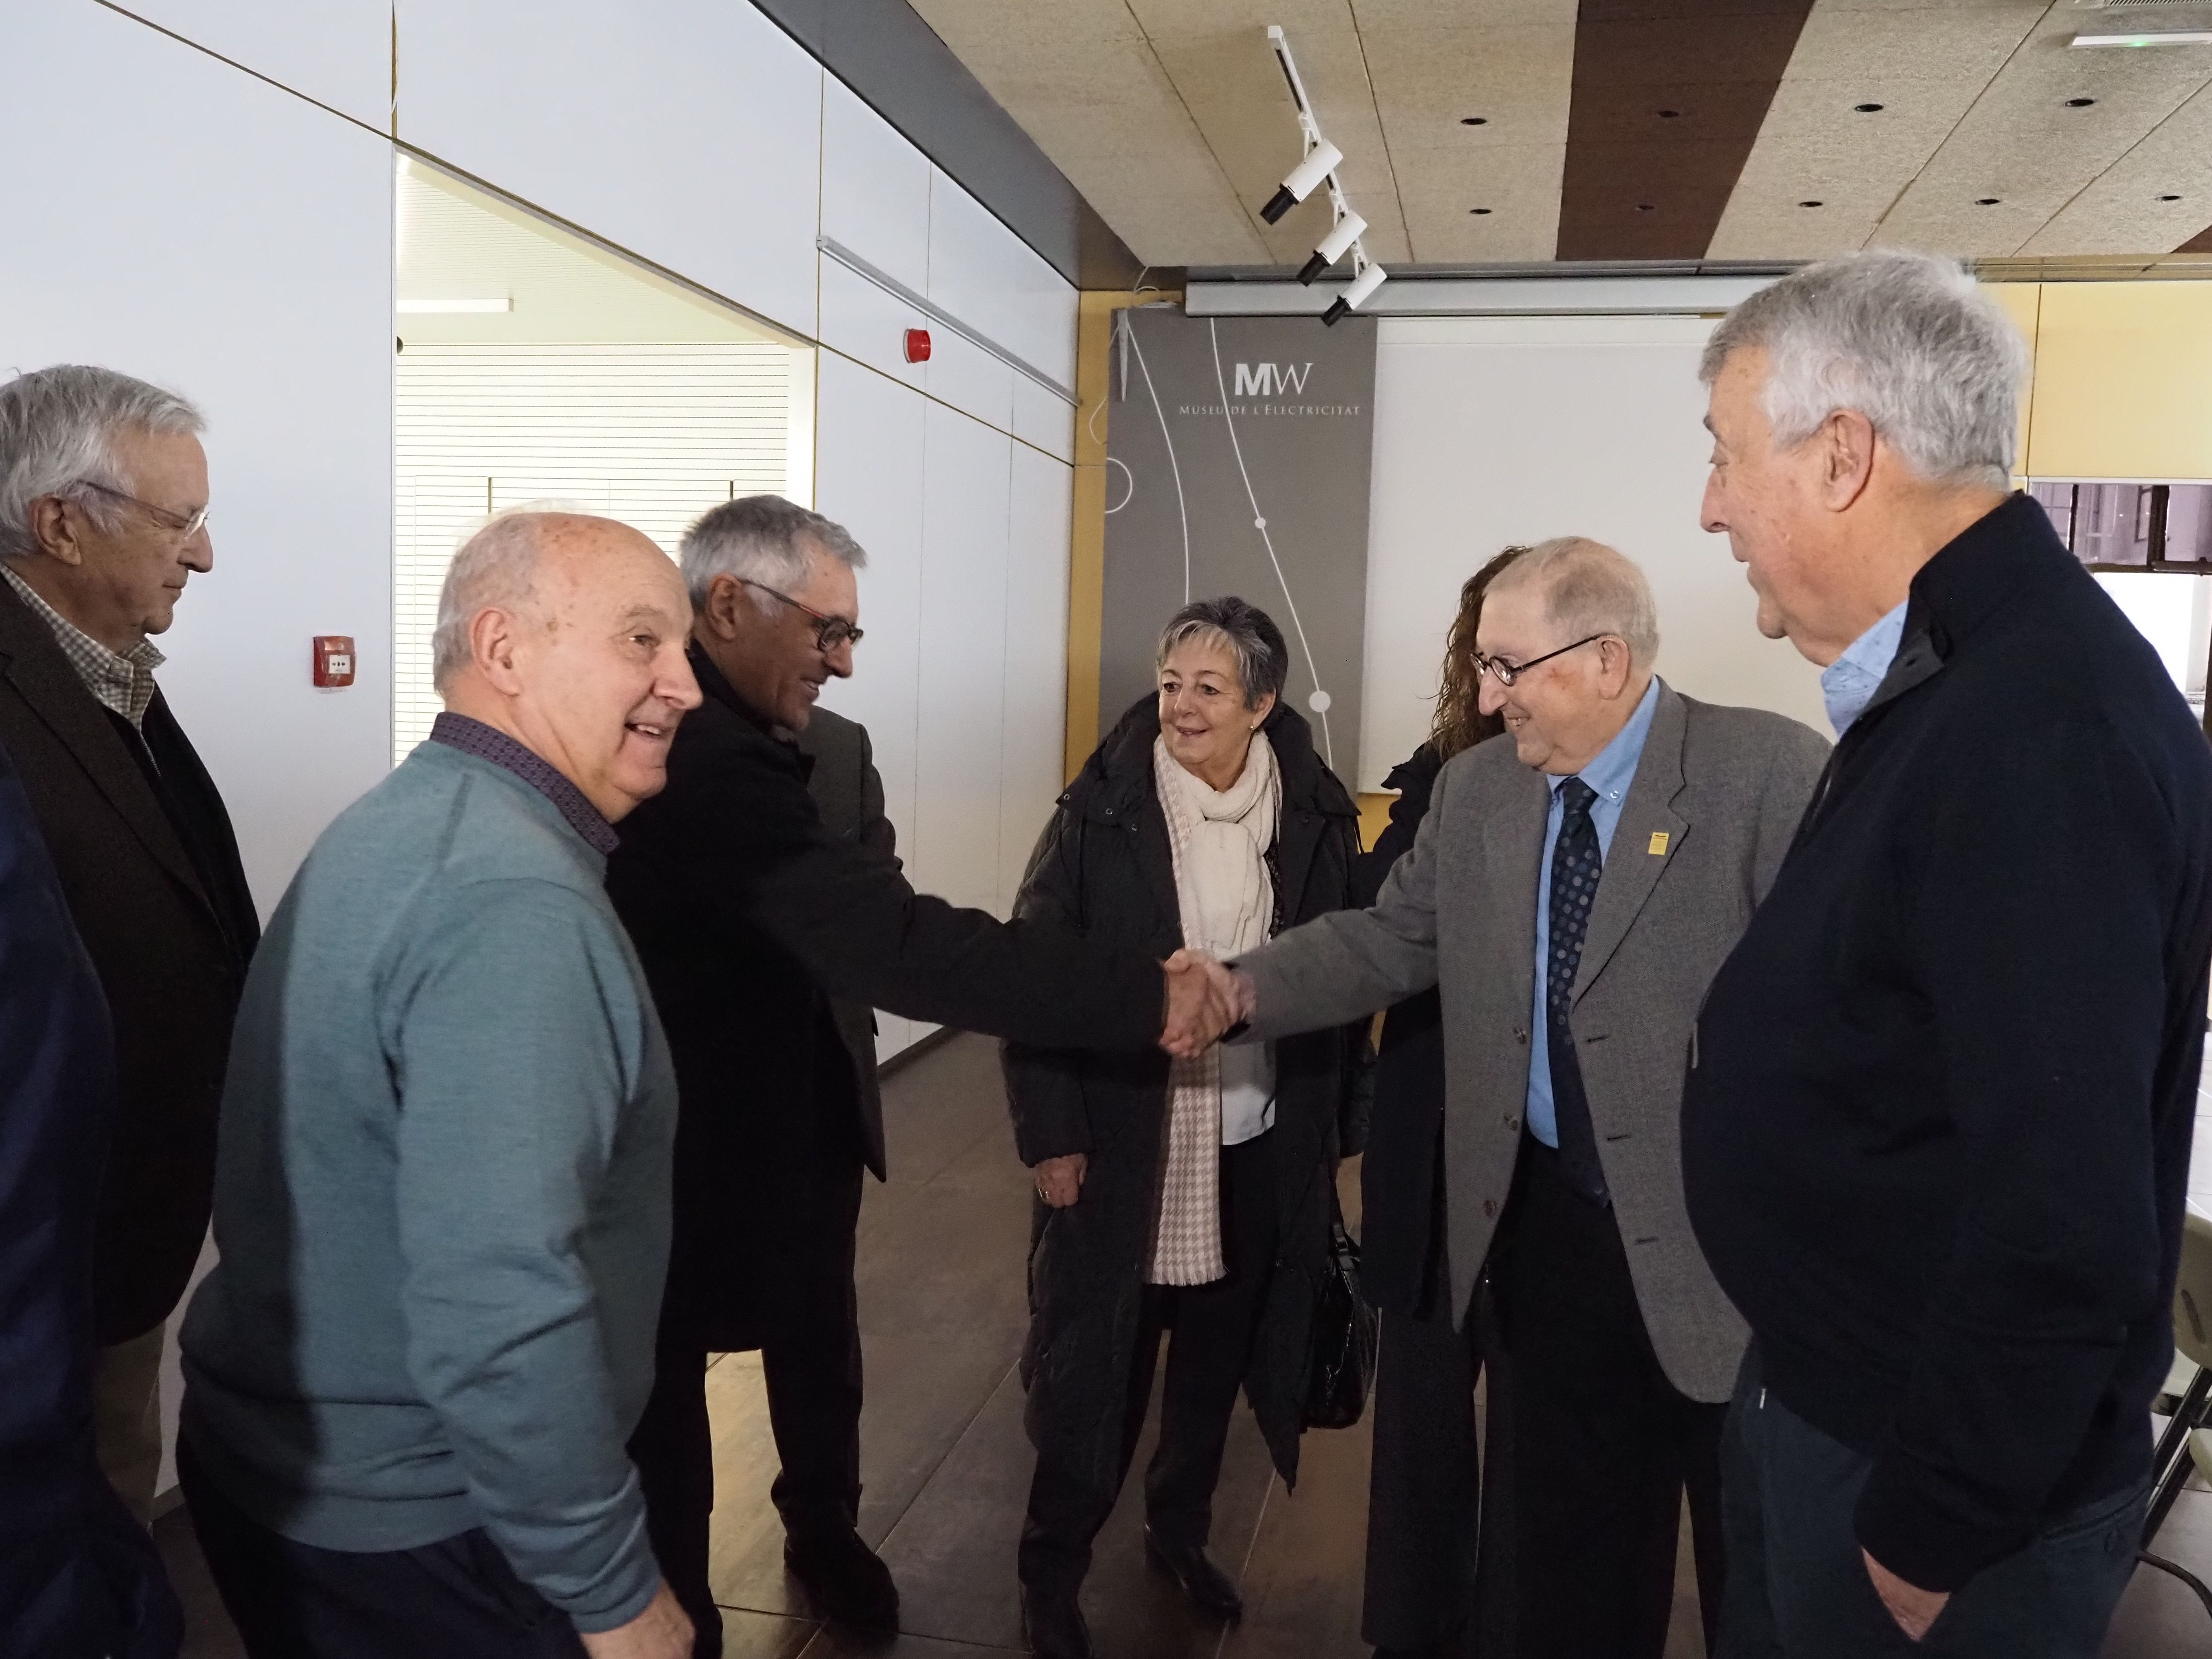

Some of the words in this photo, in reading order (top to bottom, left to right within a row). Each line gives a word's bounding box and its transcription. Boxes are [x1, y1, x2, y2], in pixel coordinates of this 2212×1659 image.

[1235, 363, 1314, 396] MW
[1179, 406, 1224, 415] MUSEU
[1231, 406, 1246, 415] DE
